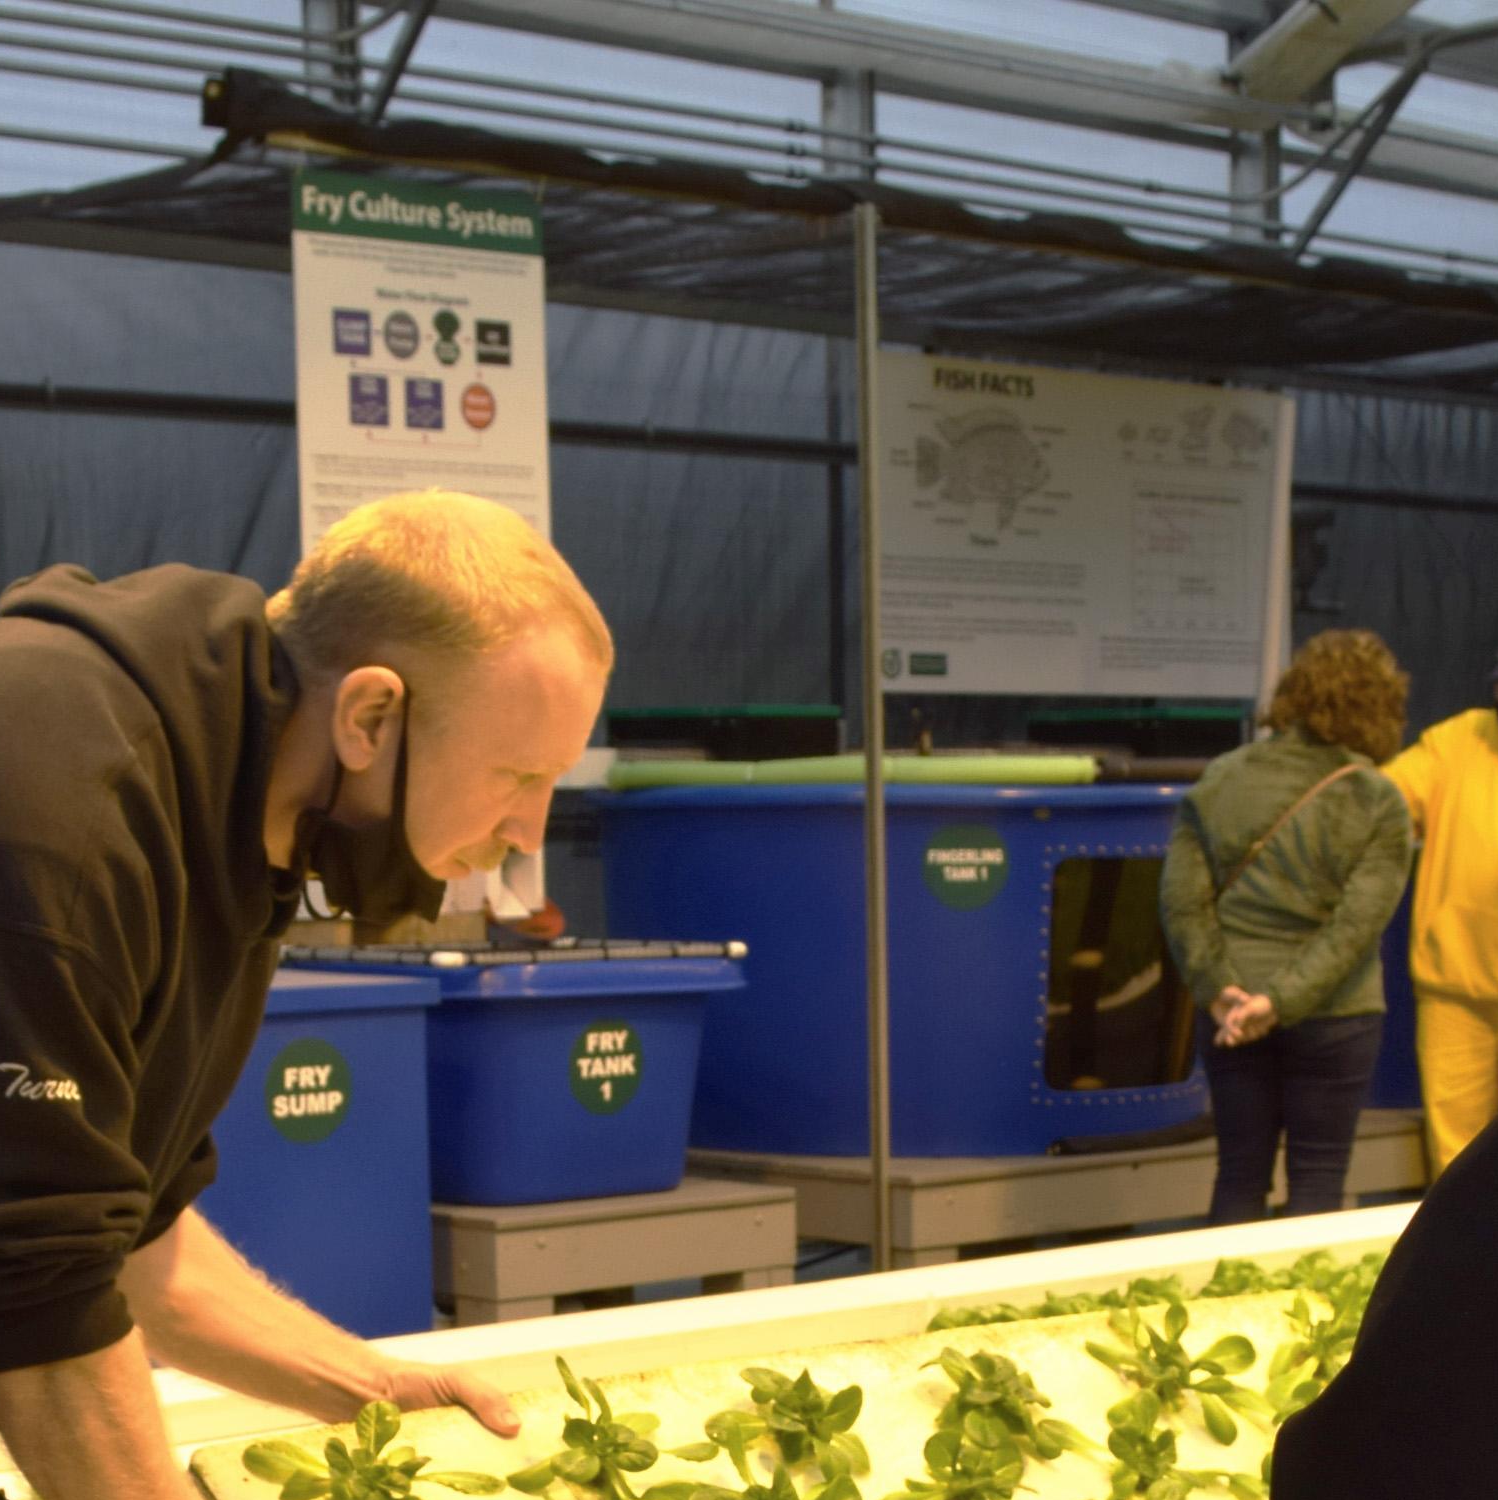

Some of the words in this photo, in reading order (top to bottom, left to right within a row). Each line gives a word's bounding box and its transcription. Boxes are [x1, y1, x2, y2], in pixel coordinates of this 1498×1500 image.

[302, 185, 345, 224] Fry
[349, 190, 442, 229] Culture
[447, 201, 534, 239] System
[933, 367, 976, 391] FISH
[980, 372, 1035, 398] FACTS
[927, 848, 1004, 866] FINGERLING
[943, 866, 978, 882] TANK
[981, 866, 989, 882] 1
[586, 1030, 629, 1053] FRY
[284, 1064, 332, 1090] FRY
[576, 1053, 637, 1079] TANK
[273, 1089, 344, 1118] SUMP
[600, 1081, 612, 1102] 1
